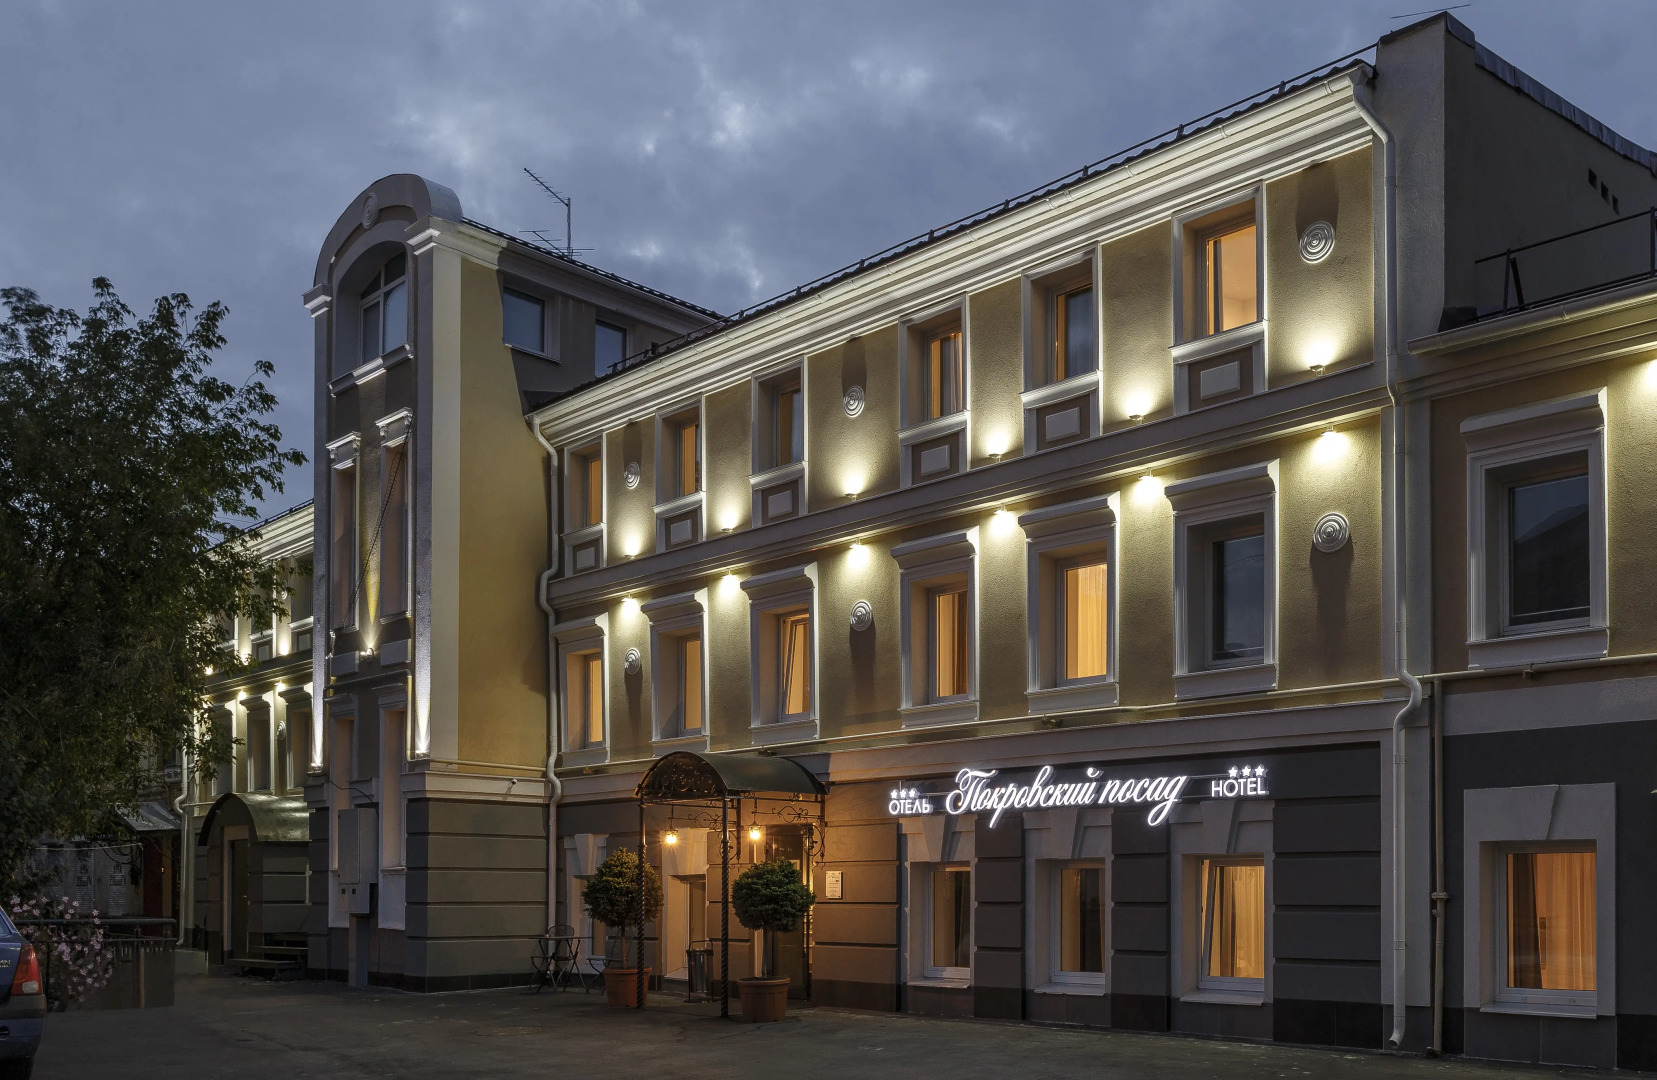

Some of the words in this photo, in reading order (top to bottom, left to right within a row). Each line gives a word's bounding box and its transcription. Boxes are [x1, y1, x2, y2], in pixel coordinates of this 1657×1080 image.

[945, 765, 1100, 829] Покровский
[1098, 775, 1189, 826] посад
[1211, 777, 1266, 798] HOTEL
[888, 799, 931, 815] ОТЕЛЬ
